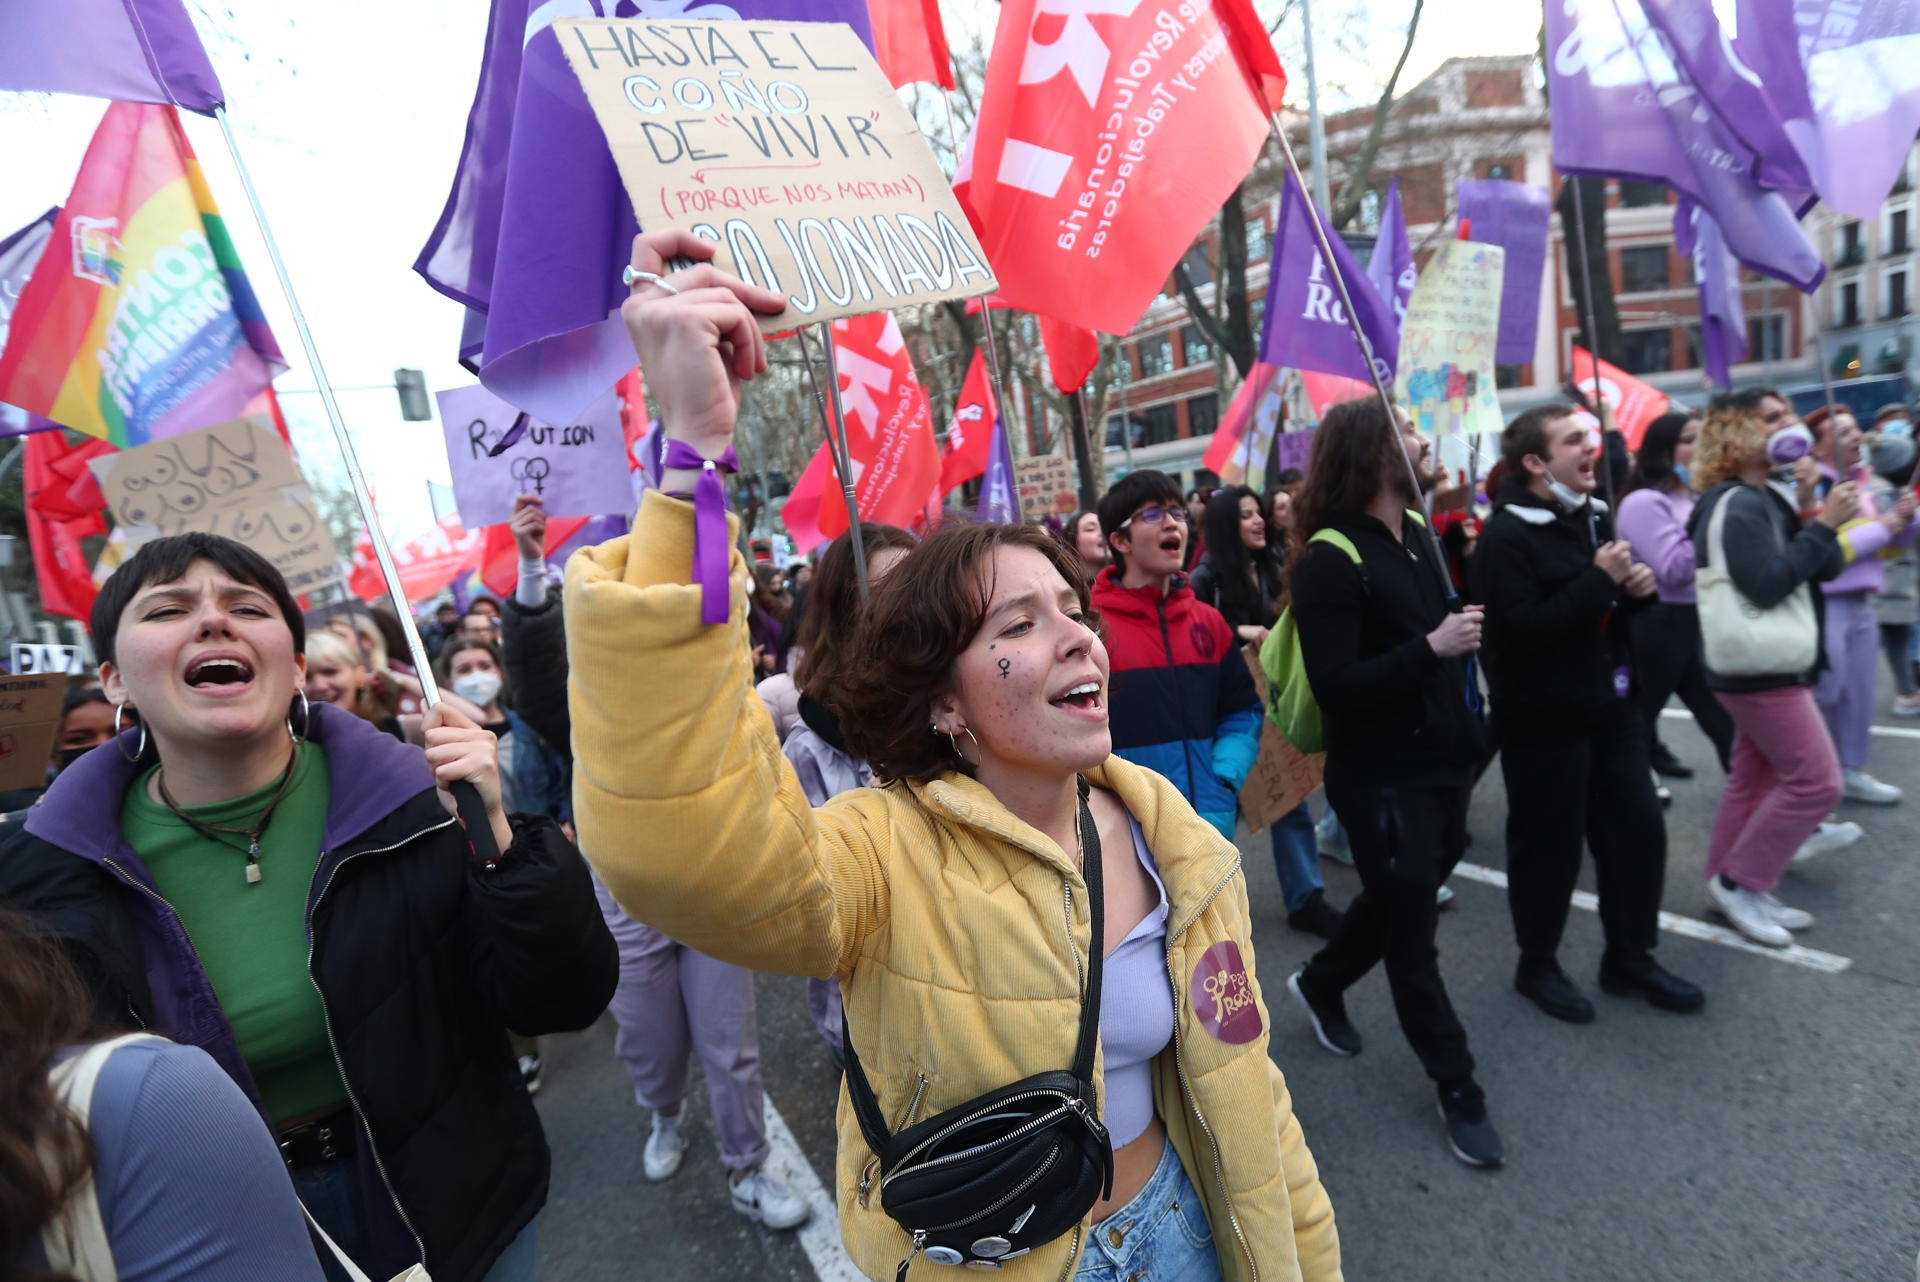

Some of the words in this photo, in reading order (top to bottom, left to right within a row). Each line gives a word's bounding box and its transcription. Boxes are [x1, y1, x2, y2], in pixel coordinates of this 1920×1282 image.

[573, 25, 749, 70] HASTA
[748, 30, 858, 72] EL
[623, 71, 809, 116] COÑO
[641, 118, 728, 164] DE
[713, 110, 892, 160] "VIVIR"
[660, 184, 772, 221] (PORQUE
[783, 182, 831, 206] NOS
[836, 173, 926, 204] MATAN)
[468, 418, 595, 460] RUTION
